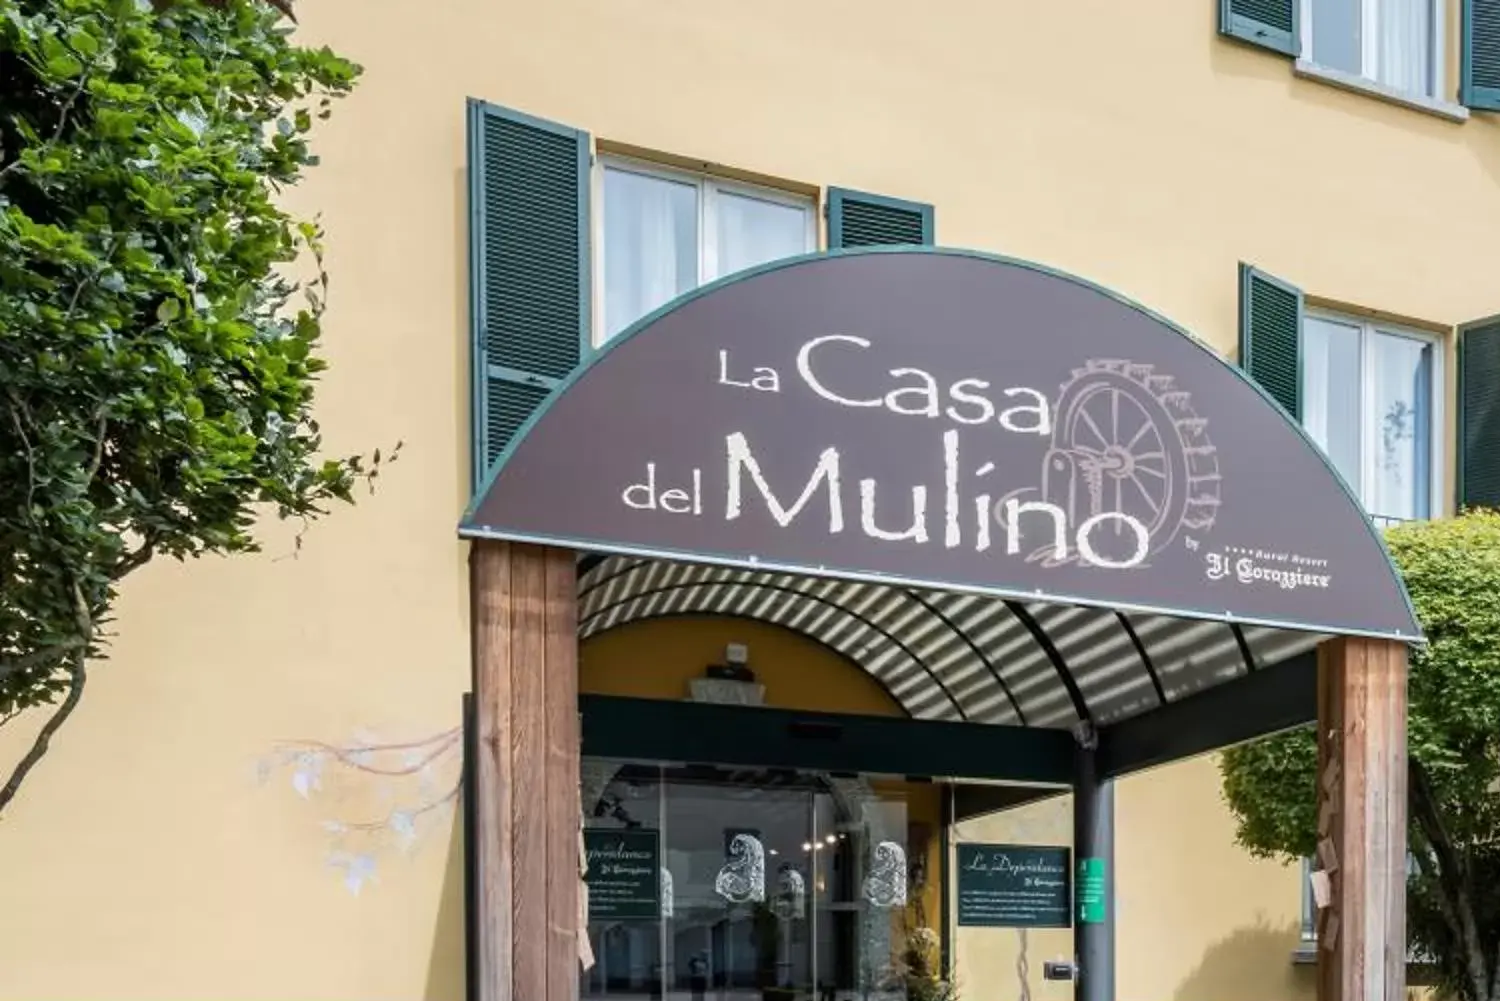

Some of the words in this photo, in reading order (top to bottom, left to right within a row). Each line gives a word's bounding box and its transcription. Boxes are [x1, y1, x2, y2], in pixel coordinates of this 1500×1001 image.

[718, 349, 781, 392] La
[796, 334, 1051, 435] Casa
[621, 462, 702, 515] del
[725, 430, 1149, 568] Mulino
[1184, 534, 1200, 552] by
